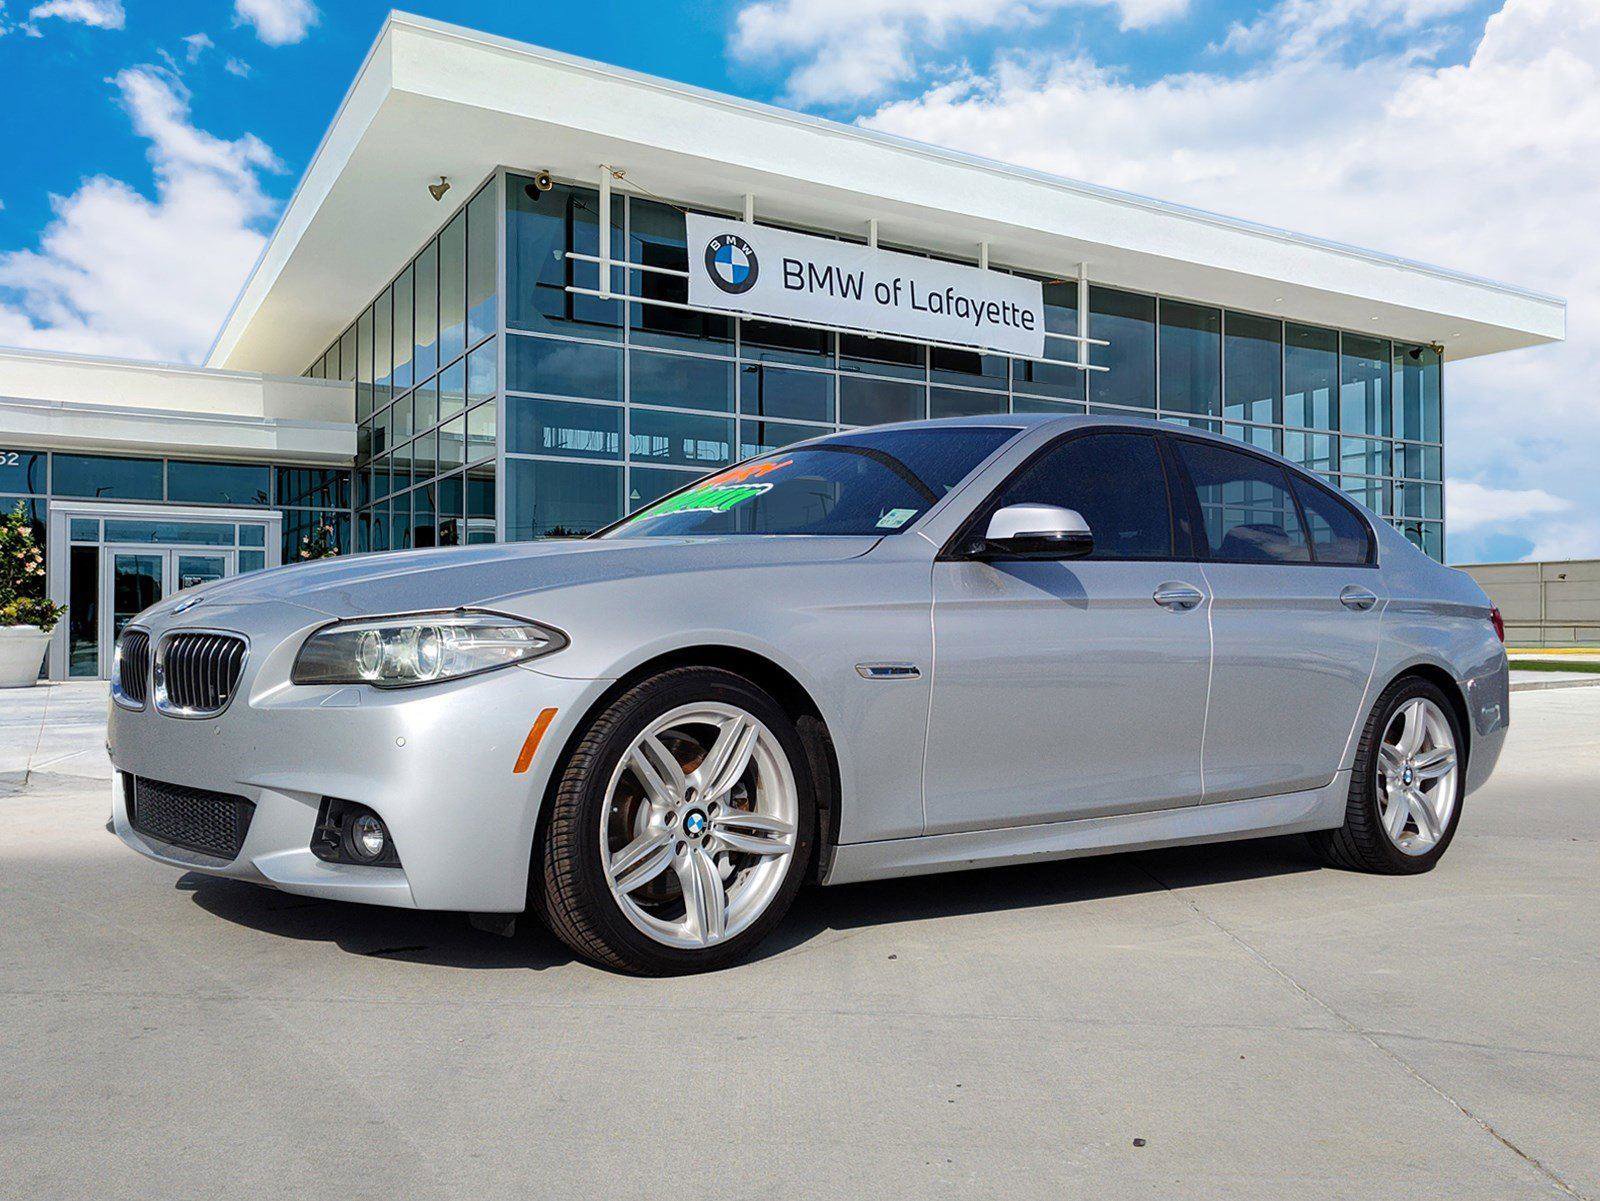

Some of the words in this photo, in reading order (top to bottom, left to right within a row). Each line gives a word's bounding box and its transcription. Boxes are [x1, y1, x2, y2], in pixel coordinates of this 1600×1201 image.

[710, 235, 753, 256] BMW
[783, 257, 864, 300] BMW
[874, 277, 902, 307] of
[910, 280, 1035, 331] Lafayette
